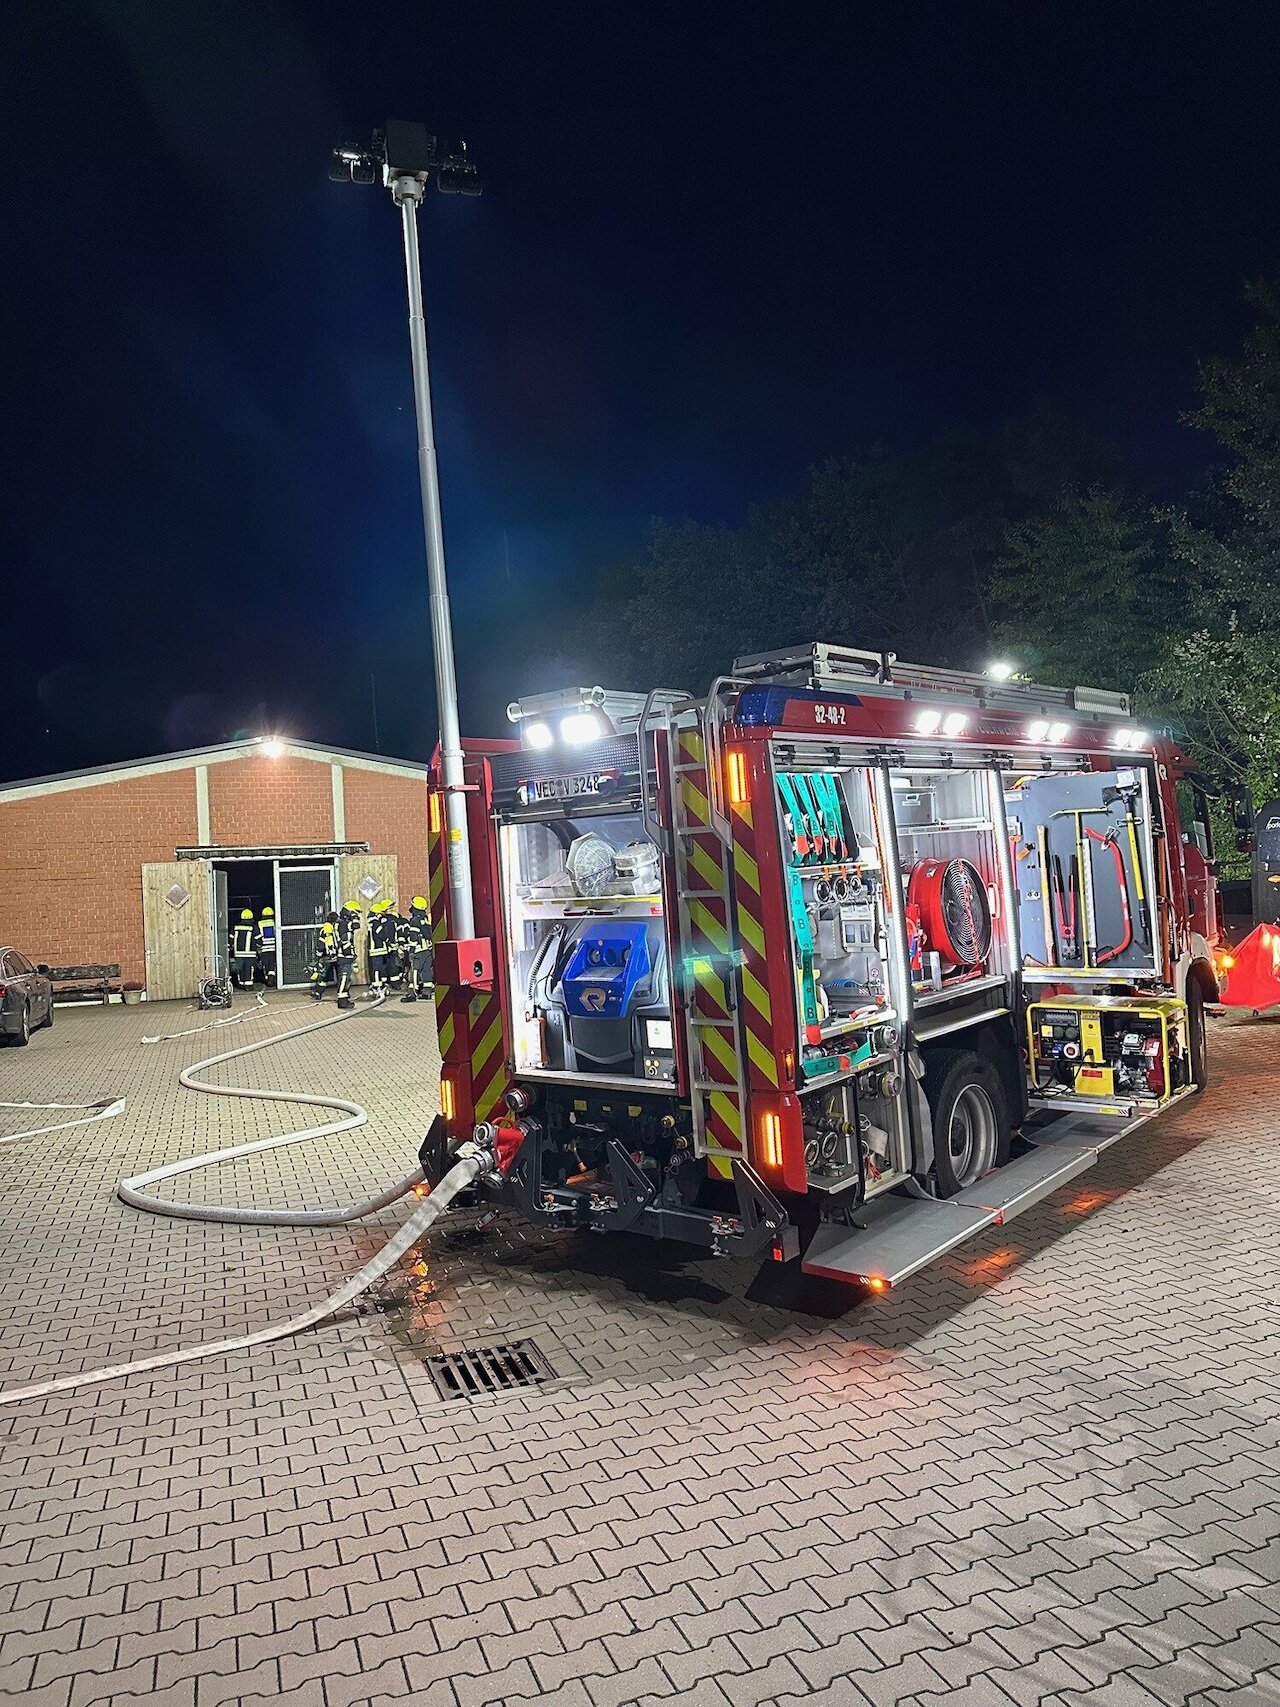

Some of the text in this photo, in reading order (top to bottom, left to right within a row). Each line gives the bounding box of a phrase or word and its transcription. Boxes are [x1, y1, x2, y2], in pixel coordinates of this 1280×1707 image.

[815, 704, 846, 725] 32-48-2
[535, 774, 600, 798] VEC V 3248
[807, 1007, 815, 1019] B
